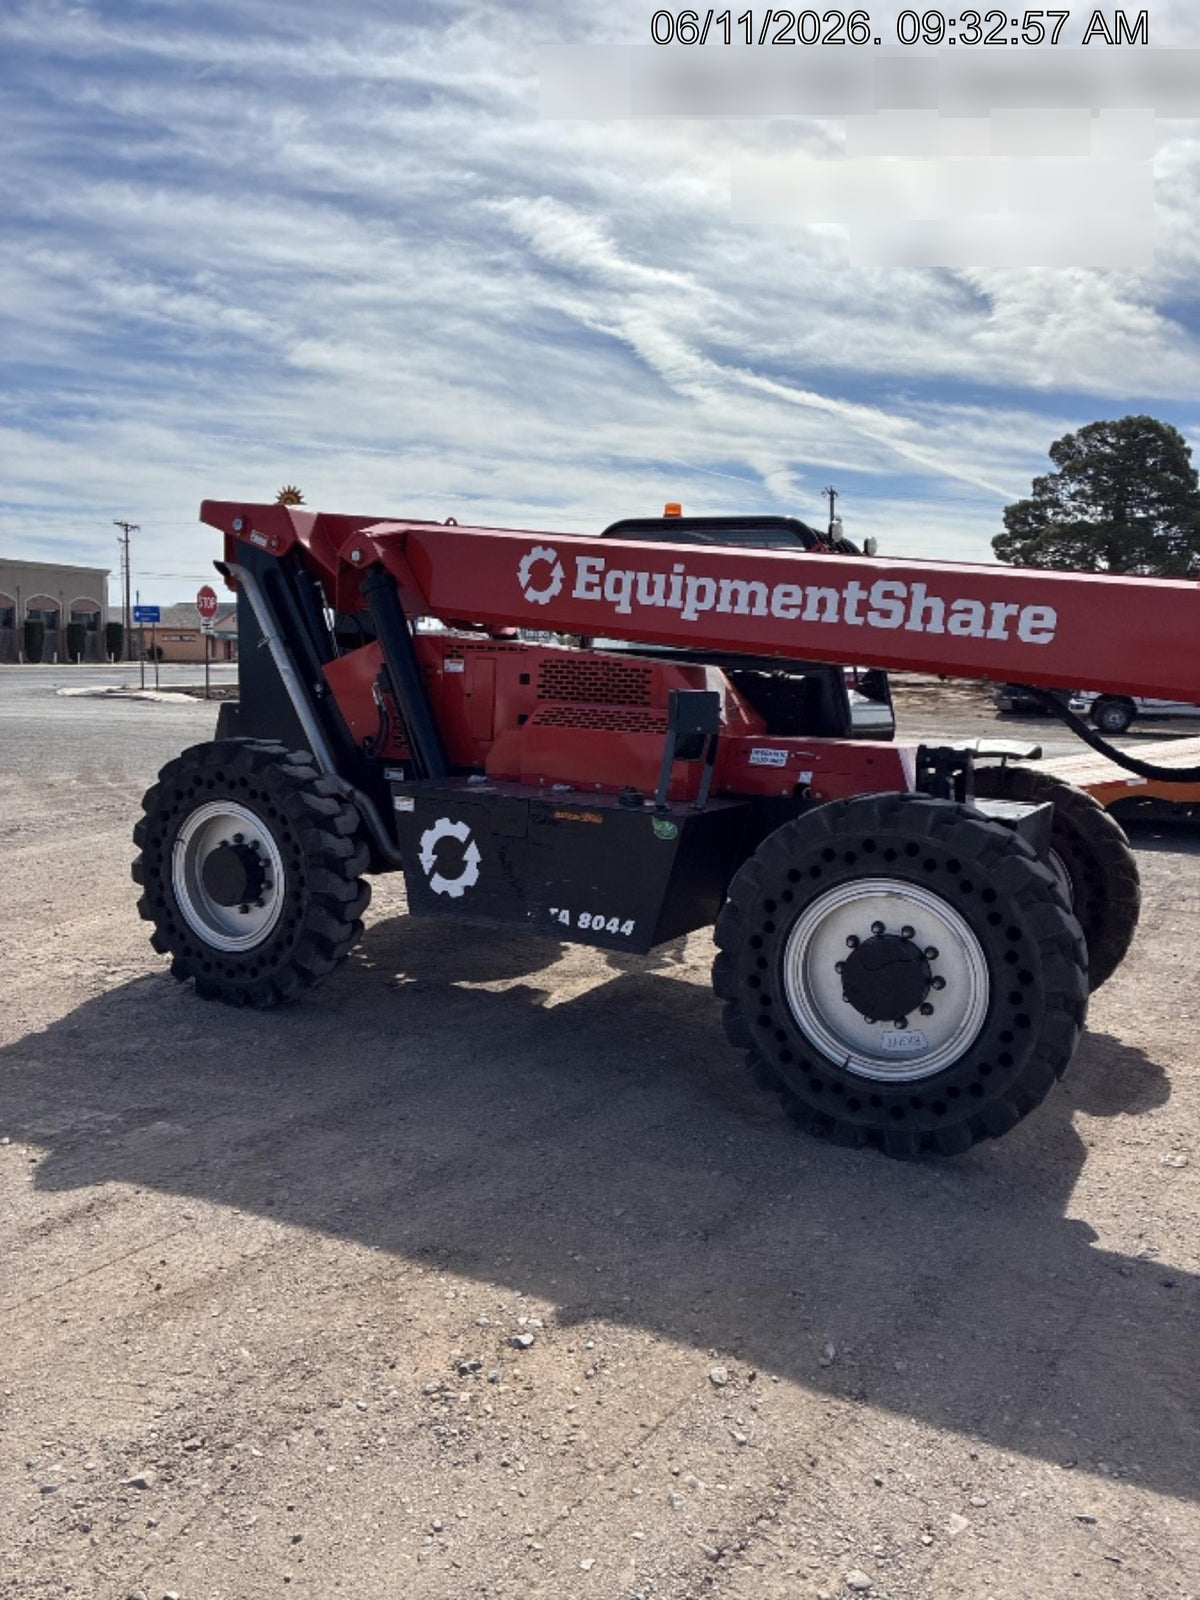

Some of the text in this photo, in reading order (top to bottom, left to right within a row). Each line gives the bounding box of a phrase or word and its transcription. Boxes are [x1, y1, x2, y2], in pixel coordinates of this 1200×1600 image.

[198, 596, 216, 609] STOP
[572, 555, 1057, 644] EquipmentShare
[577, 911, 636, 936] 8044
